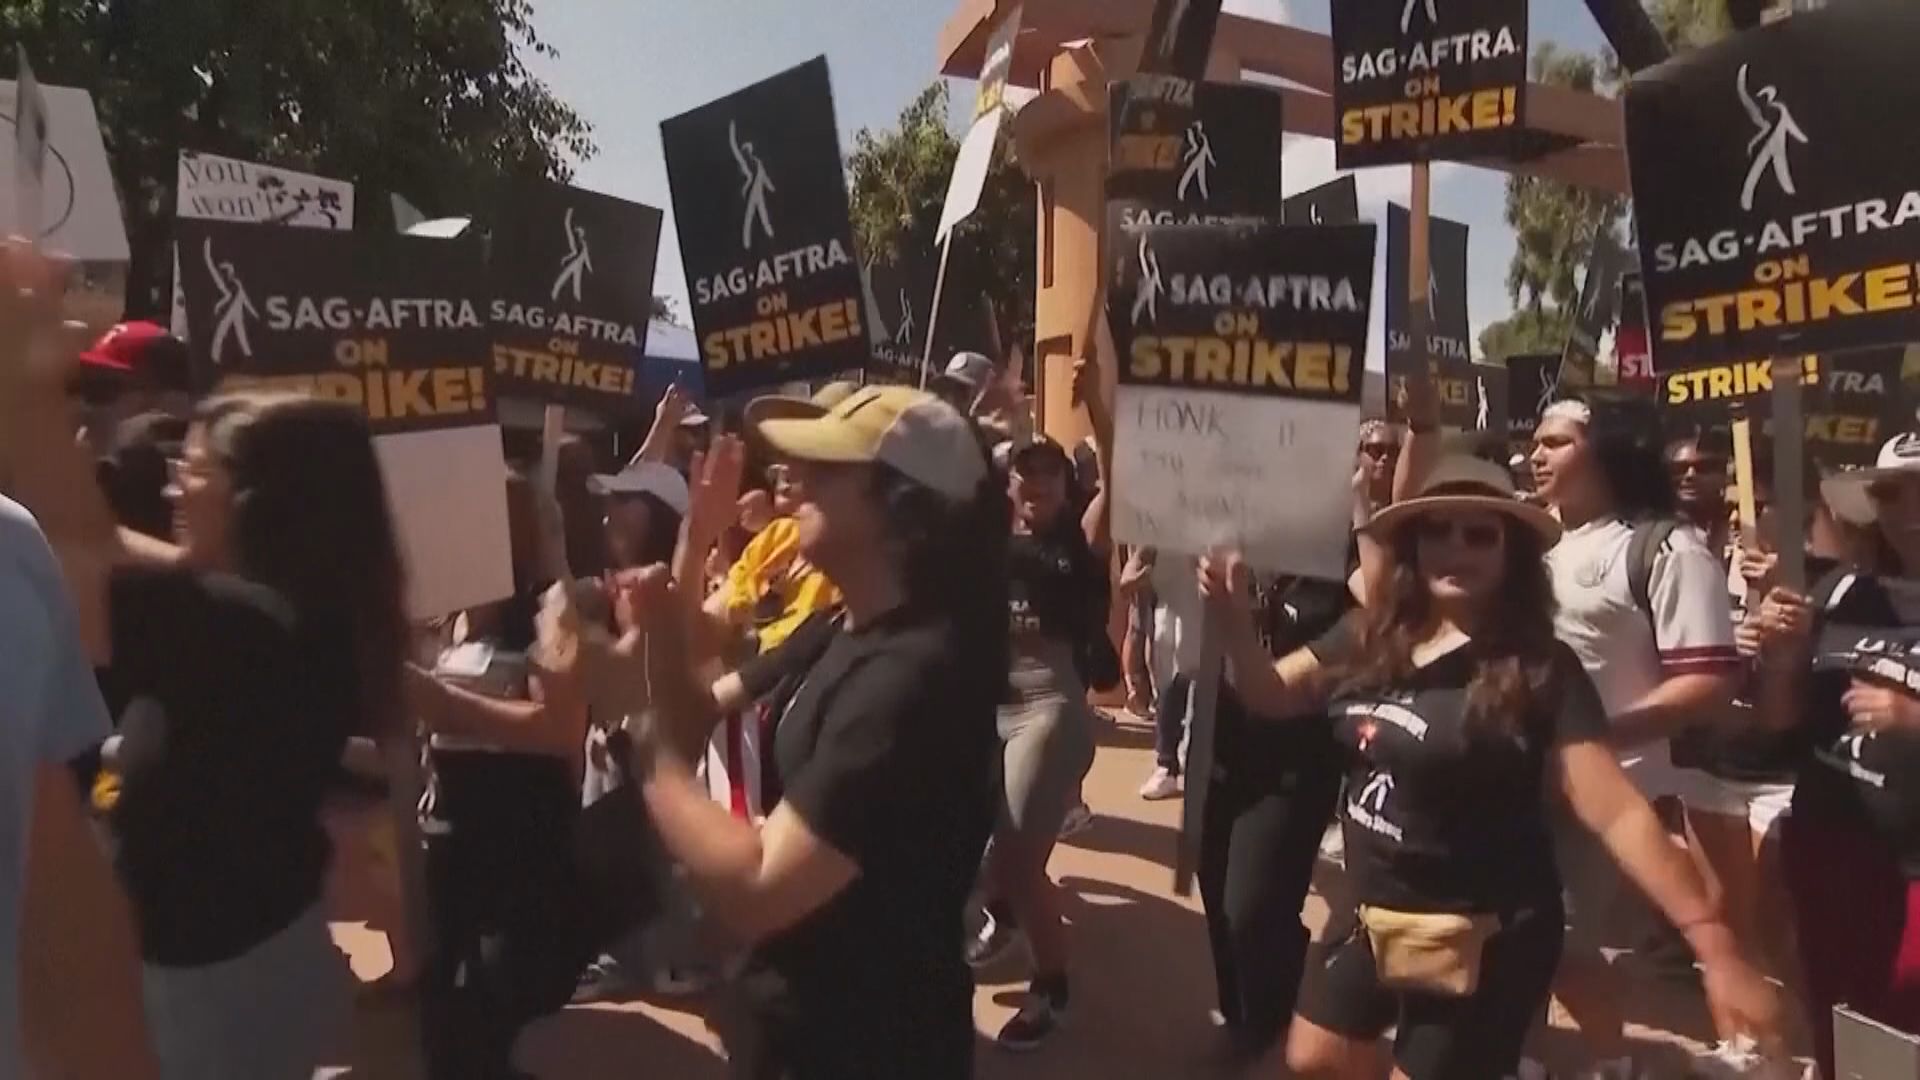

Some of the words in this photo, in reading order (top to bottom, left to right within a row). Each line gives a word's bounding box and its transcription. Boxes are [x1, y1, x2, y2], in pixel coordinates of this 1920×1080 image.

[1404, 75, 1441, 98] ON
[1342, 86, 1516, 144] STRIKE!
[1754, 254, 1810, 283] ON
[757, 291, 788, 316] ON
[704, 298, 862, 370] STRIKE!
[1214, 310, 1258, 335] ON
[335, 337, 388, 366] ON
[549, 337, 579, 356] ON
[1130, 335, 1351, 393] STRIKE!
[1667, 354, 1820, 404] STRIK!
